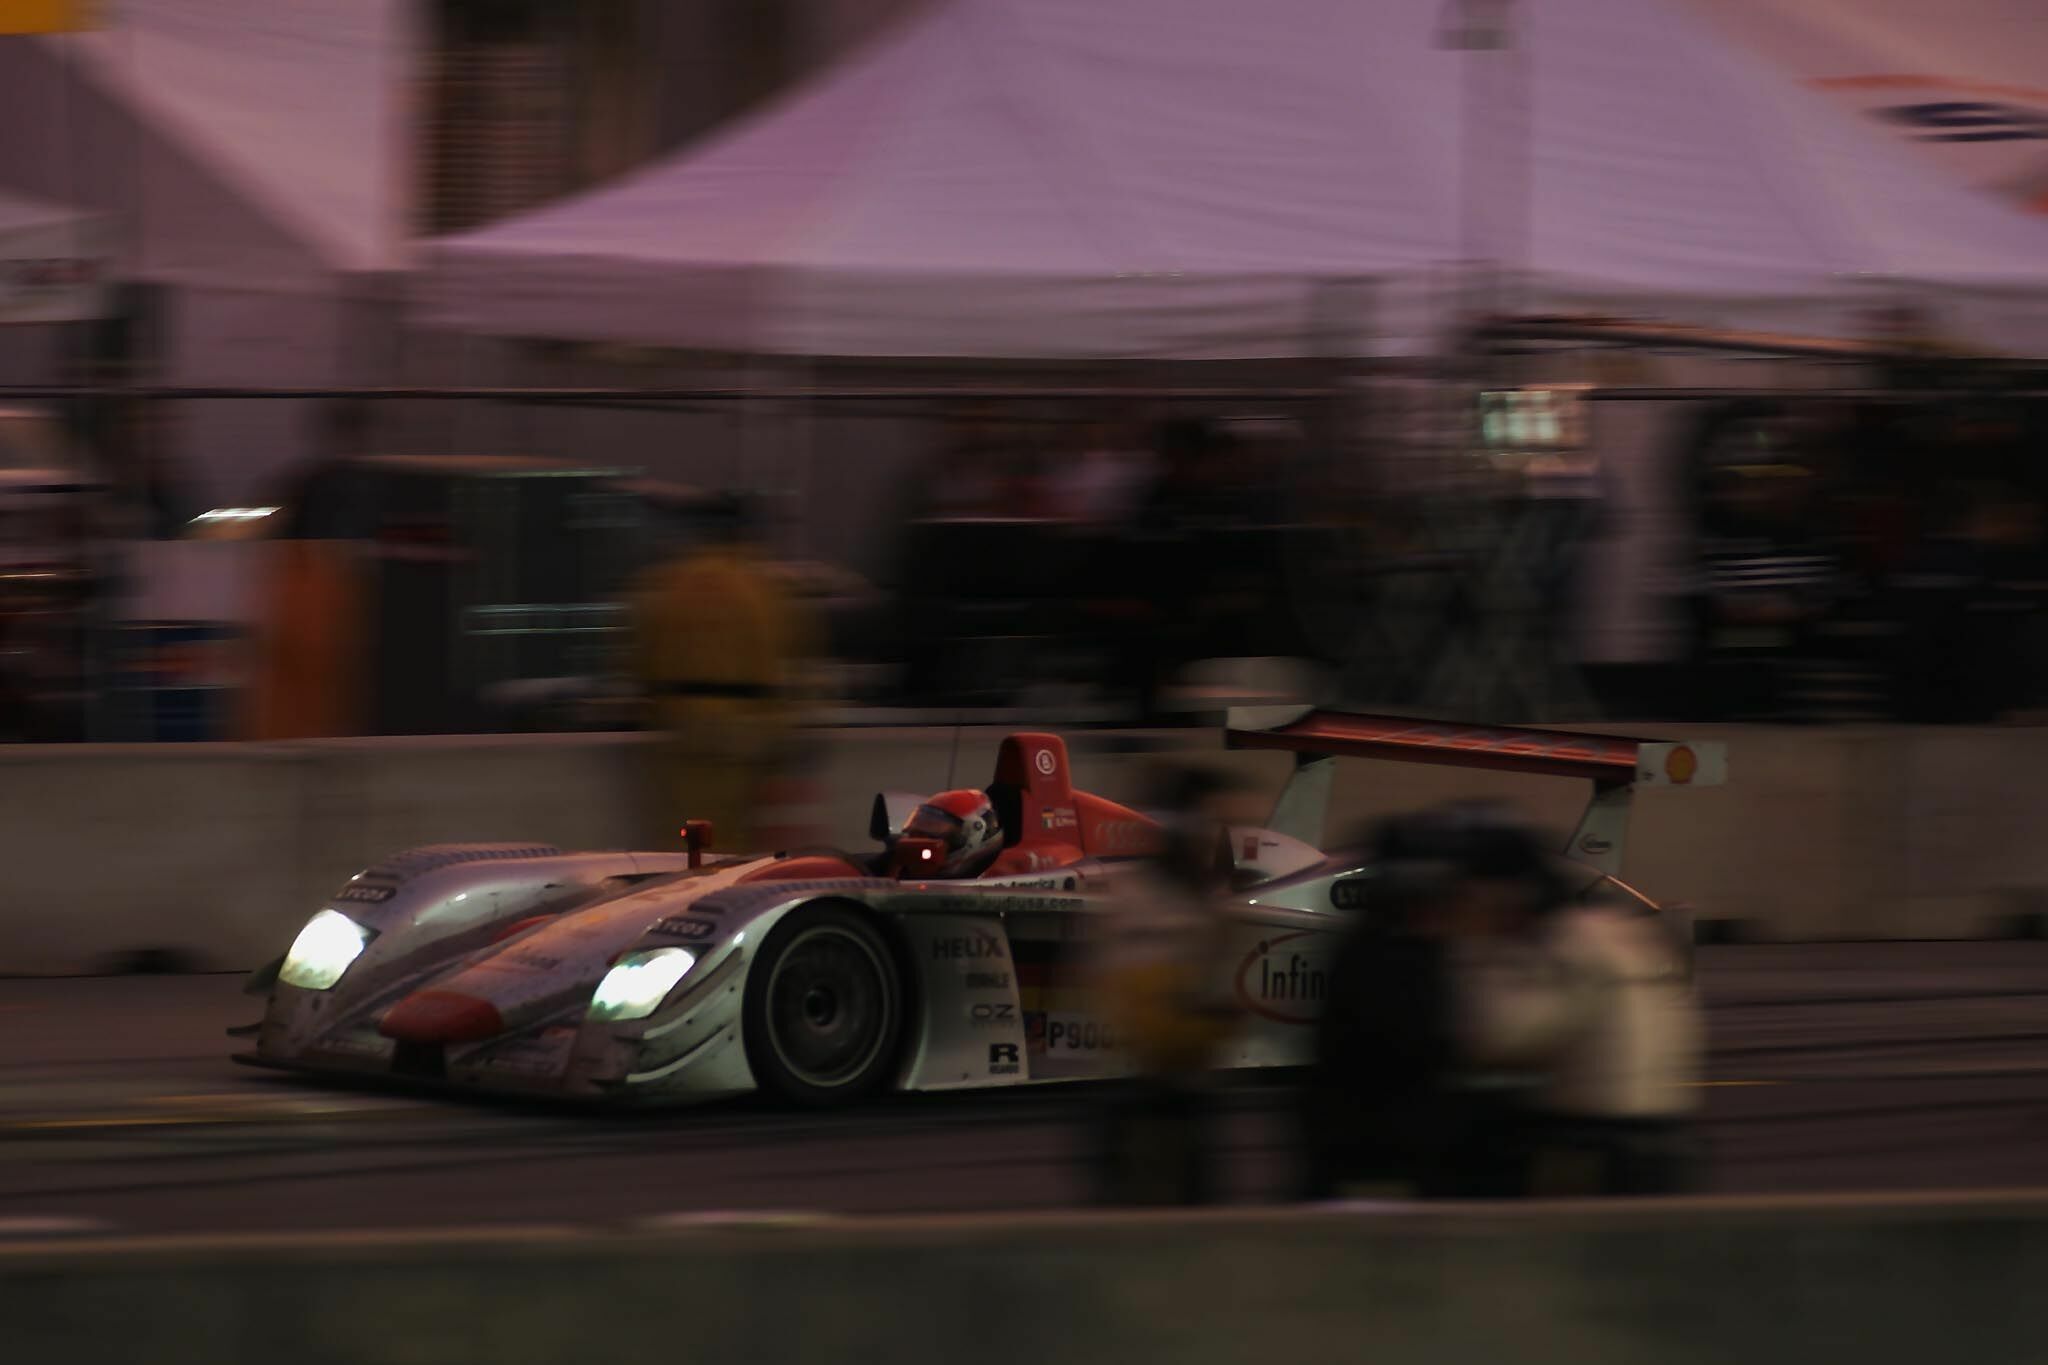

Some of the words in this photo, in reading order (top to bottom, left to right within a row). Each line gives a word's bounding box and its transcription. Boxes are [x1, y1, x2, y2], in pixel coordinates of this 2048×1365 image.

[933, 937, 1003, 958] HELIX
[1261, 943, 1327, 999] Infin
[971, 1004, 1014, 1019] OZ
[989, 1043, 1018, 1063] R
